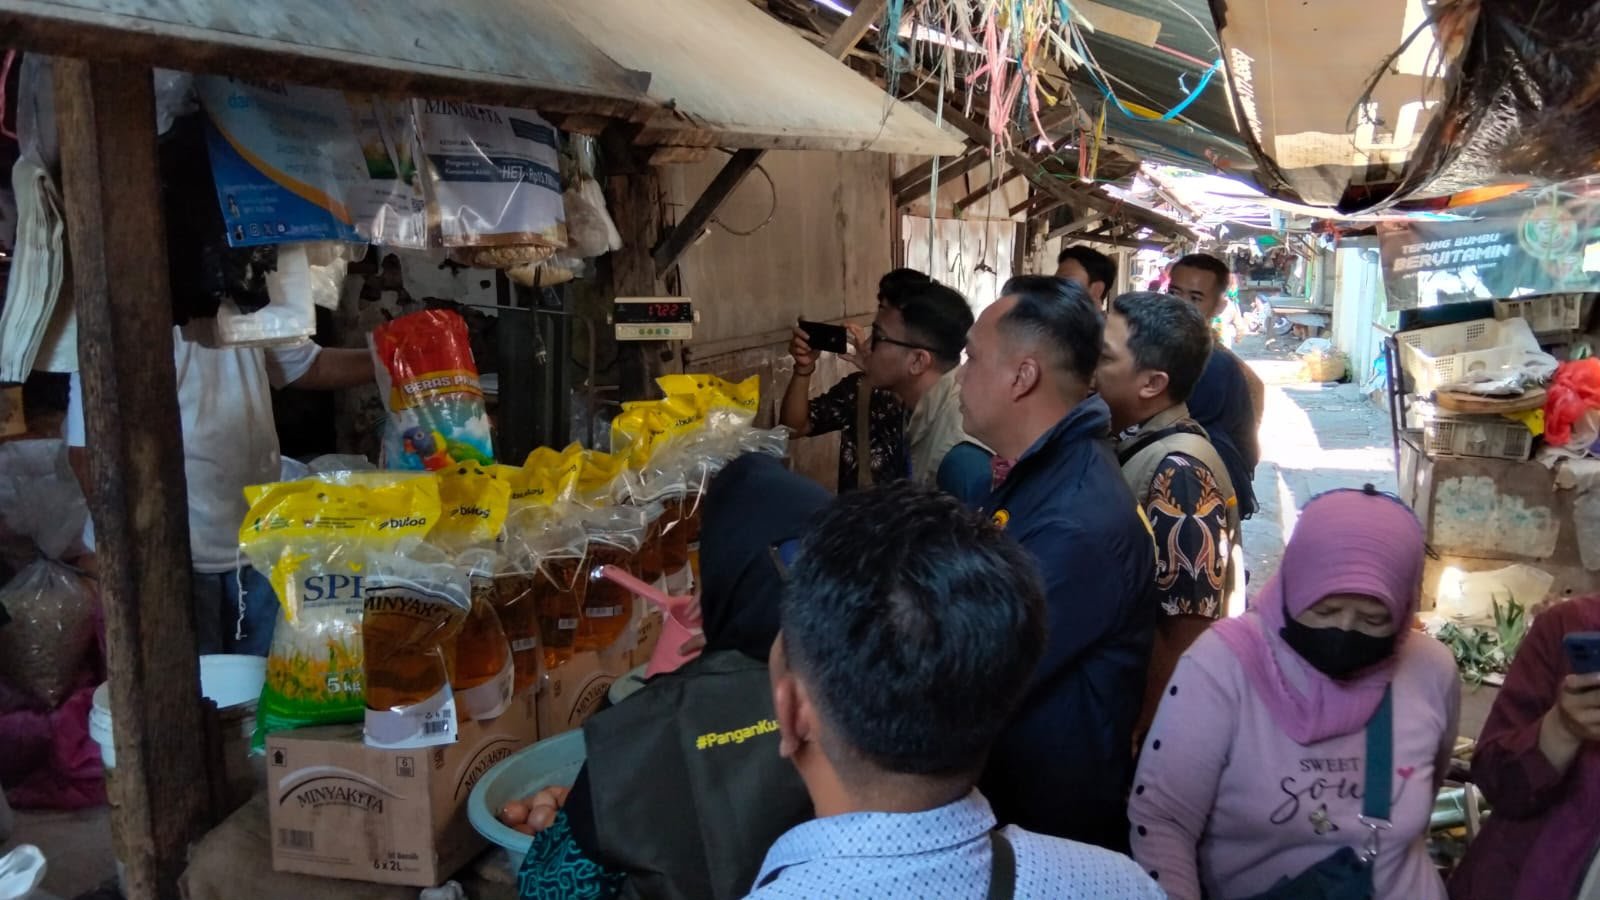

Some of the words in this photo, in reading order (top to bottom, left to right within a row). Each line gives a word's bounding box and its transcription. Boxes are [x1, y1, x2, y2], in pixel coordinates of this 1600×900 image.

[502, 165, 524, 180] HET
[1402, 240, 1451, 255] TEPUNG
[1454, 233, 1501, 247] BUMBU
[1392, 243, 1512, 272] BERVITAMIN
[404, 376, 452, 394] BERAS
[365, 595, 450, 619] MINYAK
[327, 677, 341, 694] 5
[343, 680, 361, 694] kg
[1299, 757, 1361, 773] SWEET
[297, 784, 384, 815] MINYAKITA
[1270, 775, 1365, 825] Sou
[373, 858, 381, 870] 6
